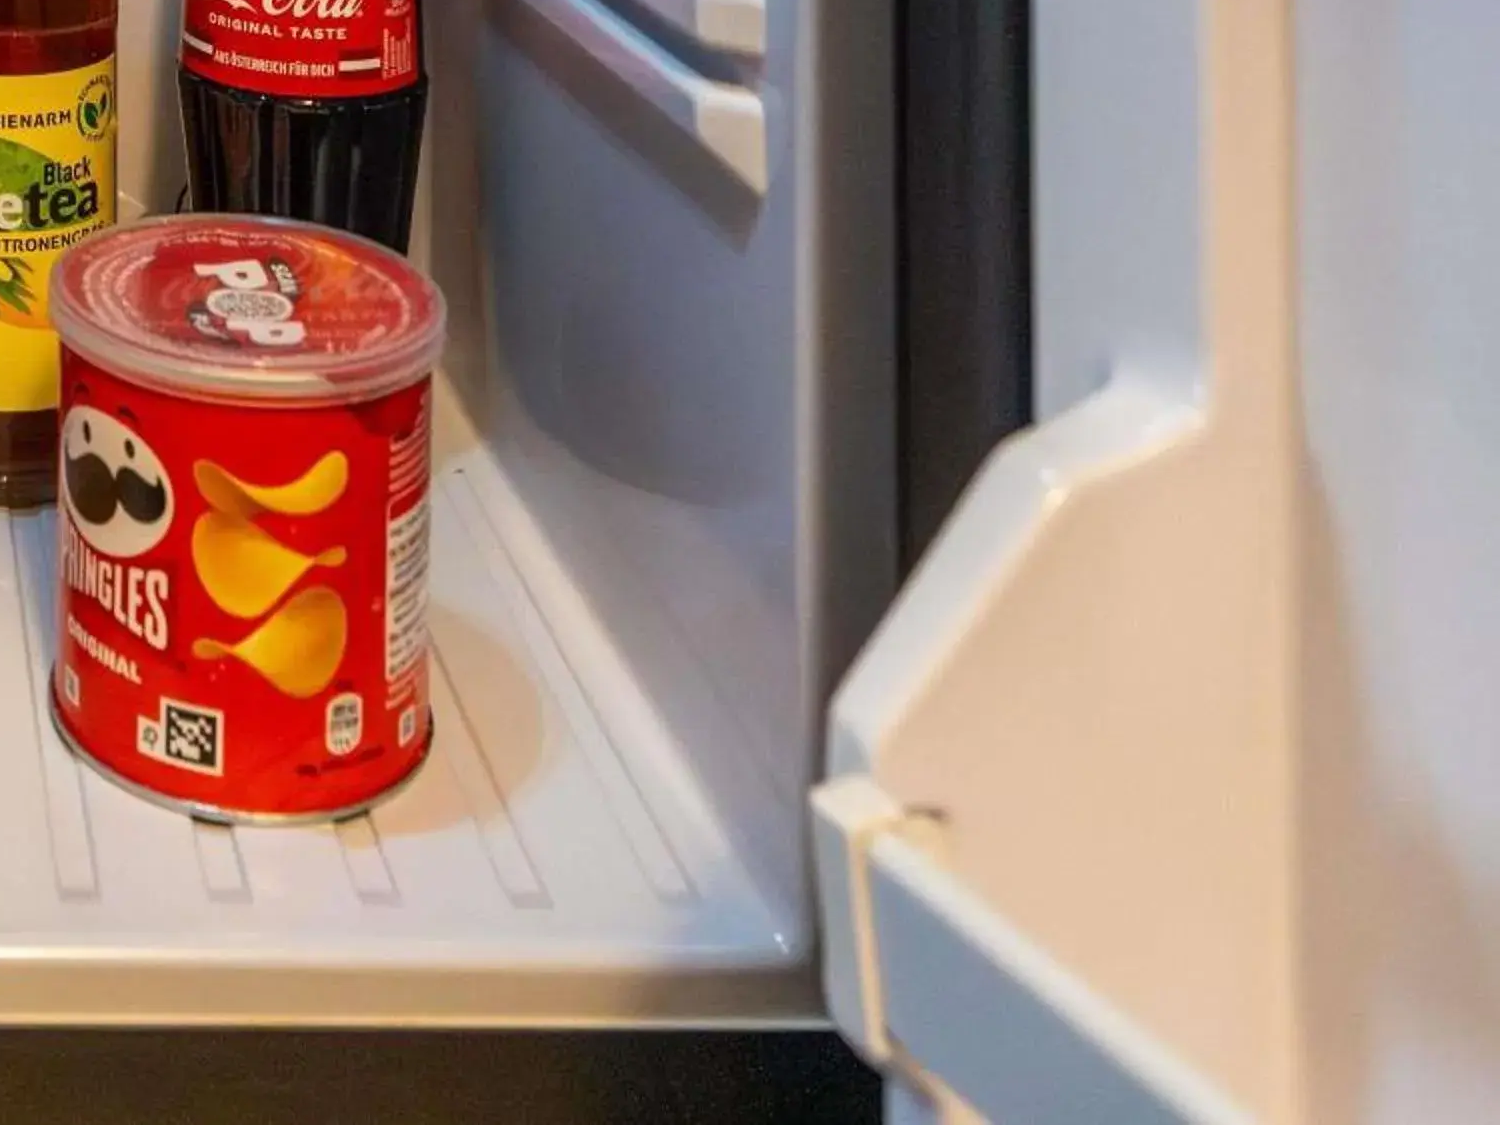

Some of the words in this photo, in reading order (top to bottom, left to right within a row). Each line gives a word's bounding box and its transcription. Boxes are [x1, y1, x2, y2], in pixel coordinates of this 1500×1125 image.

[208, 11, 283, 38] ORIGINAL
[290, 26, 347, 40] TASTE
[43, 155, 91, 186] Black
[67, 612, 142, 685] ORIGINAL
